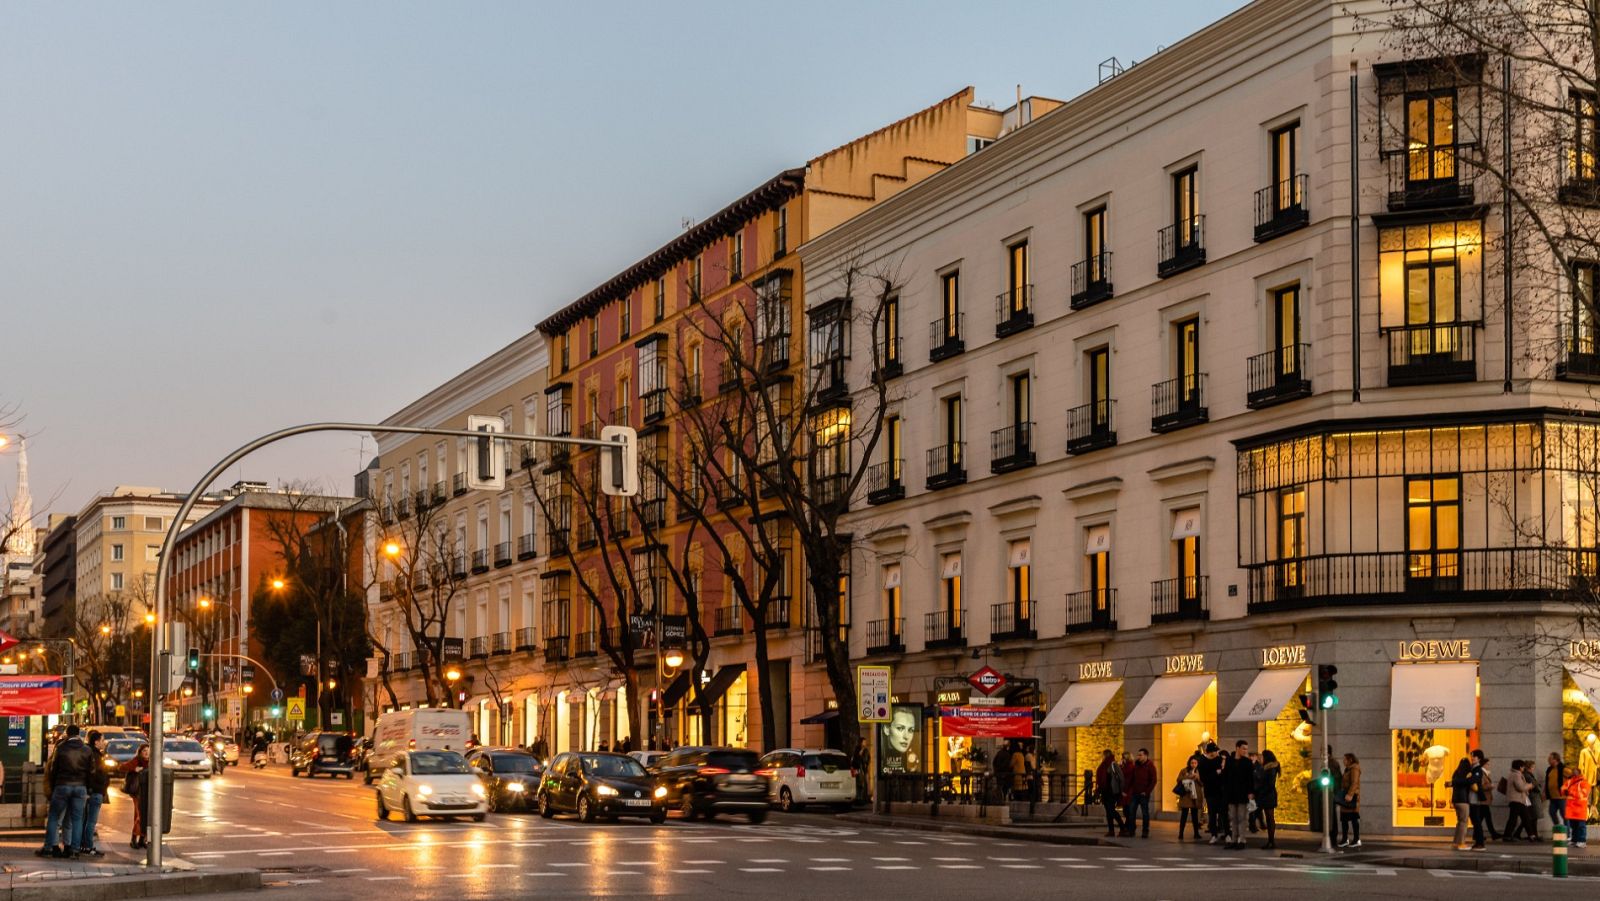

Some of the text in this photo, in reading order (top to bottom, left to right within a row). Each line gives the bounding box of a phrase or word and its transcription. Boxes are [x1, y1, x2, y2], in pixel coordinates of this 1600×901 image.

[1262, 645, 1306, 666] LOEWE
[1400, 640, 1470, 659] LOEWE
[1079, 661, 1112, 678] LOEWE
[1165, 654, 1204, 673] LOEWE
[938, 692, 960, 702] PRADA
